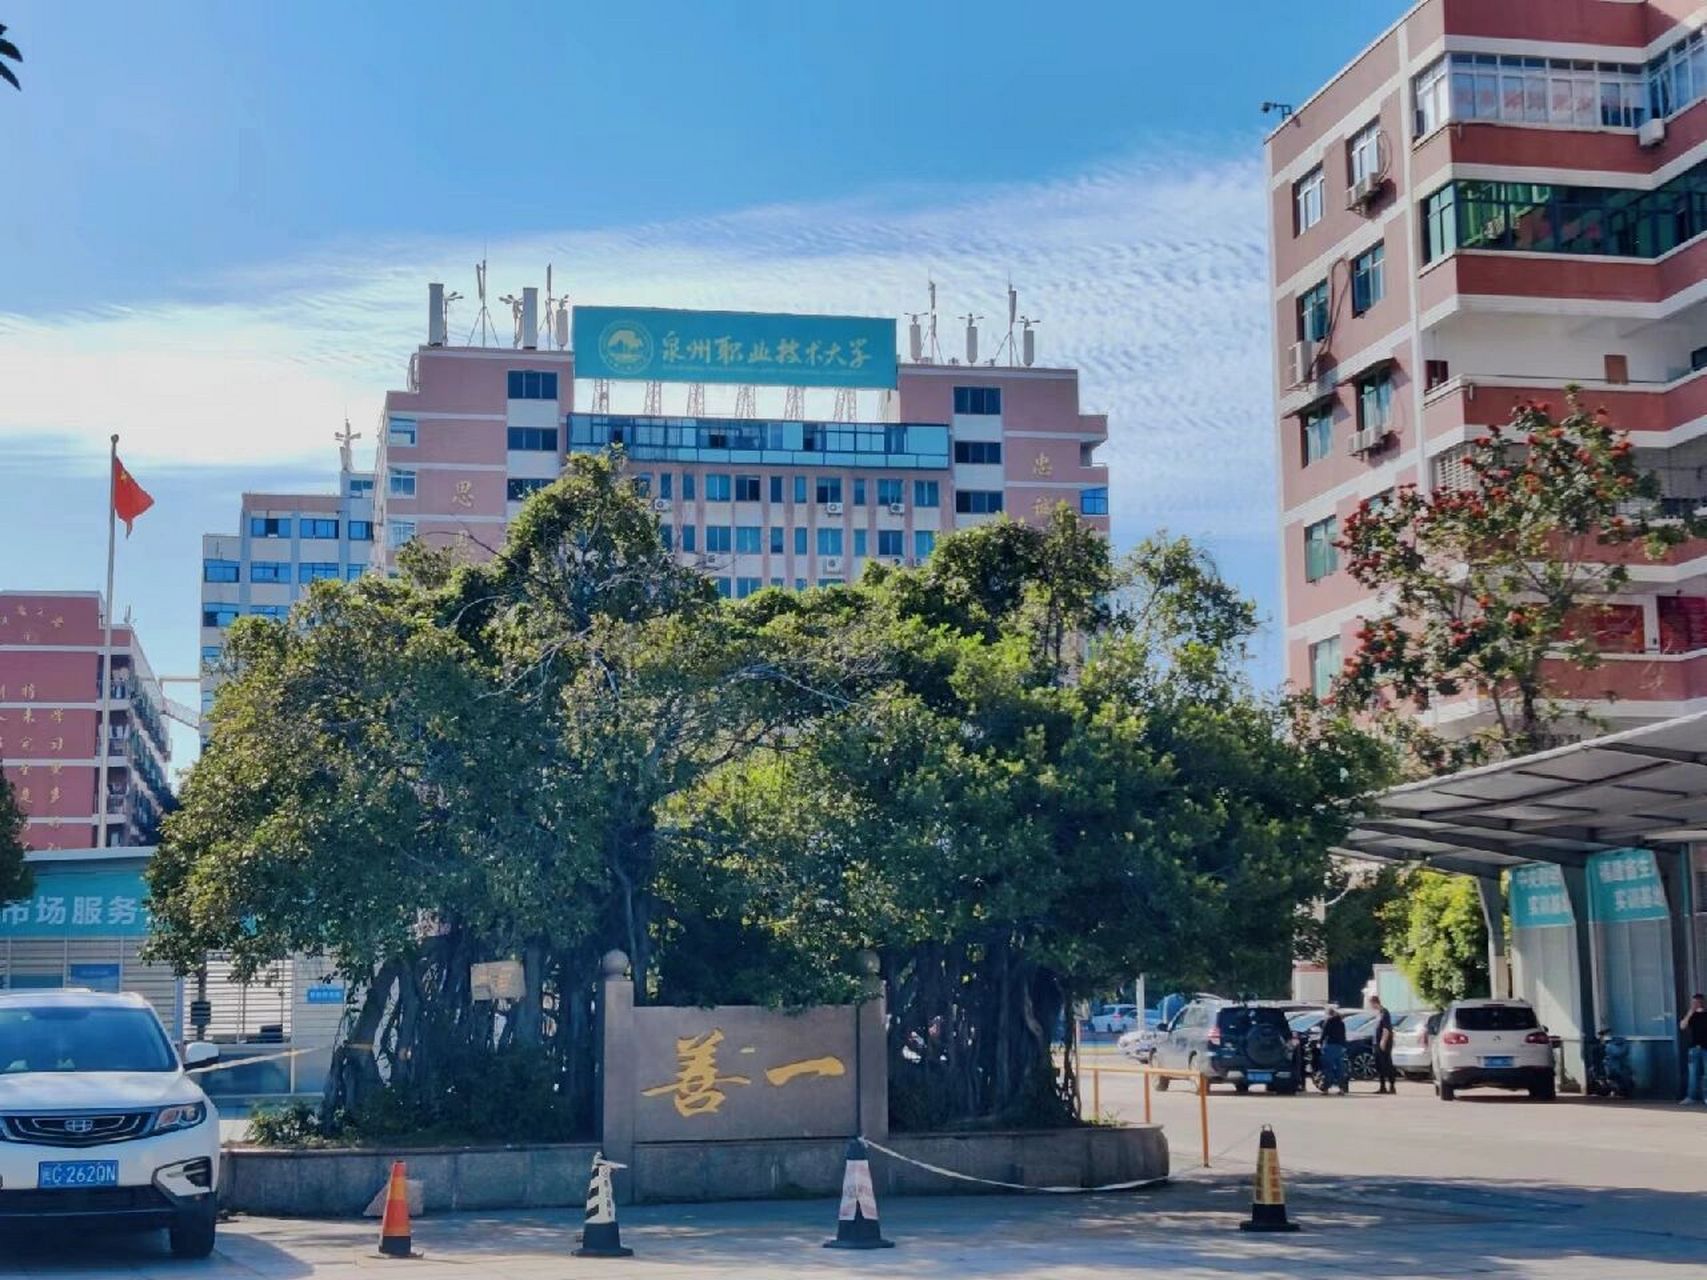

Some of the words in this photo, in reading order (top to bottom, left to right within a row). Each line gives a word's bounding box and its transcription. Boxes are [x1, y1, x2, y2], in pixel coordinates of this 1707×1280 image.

[662, 330, 873, 369] 泉州职业技术大学
